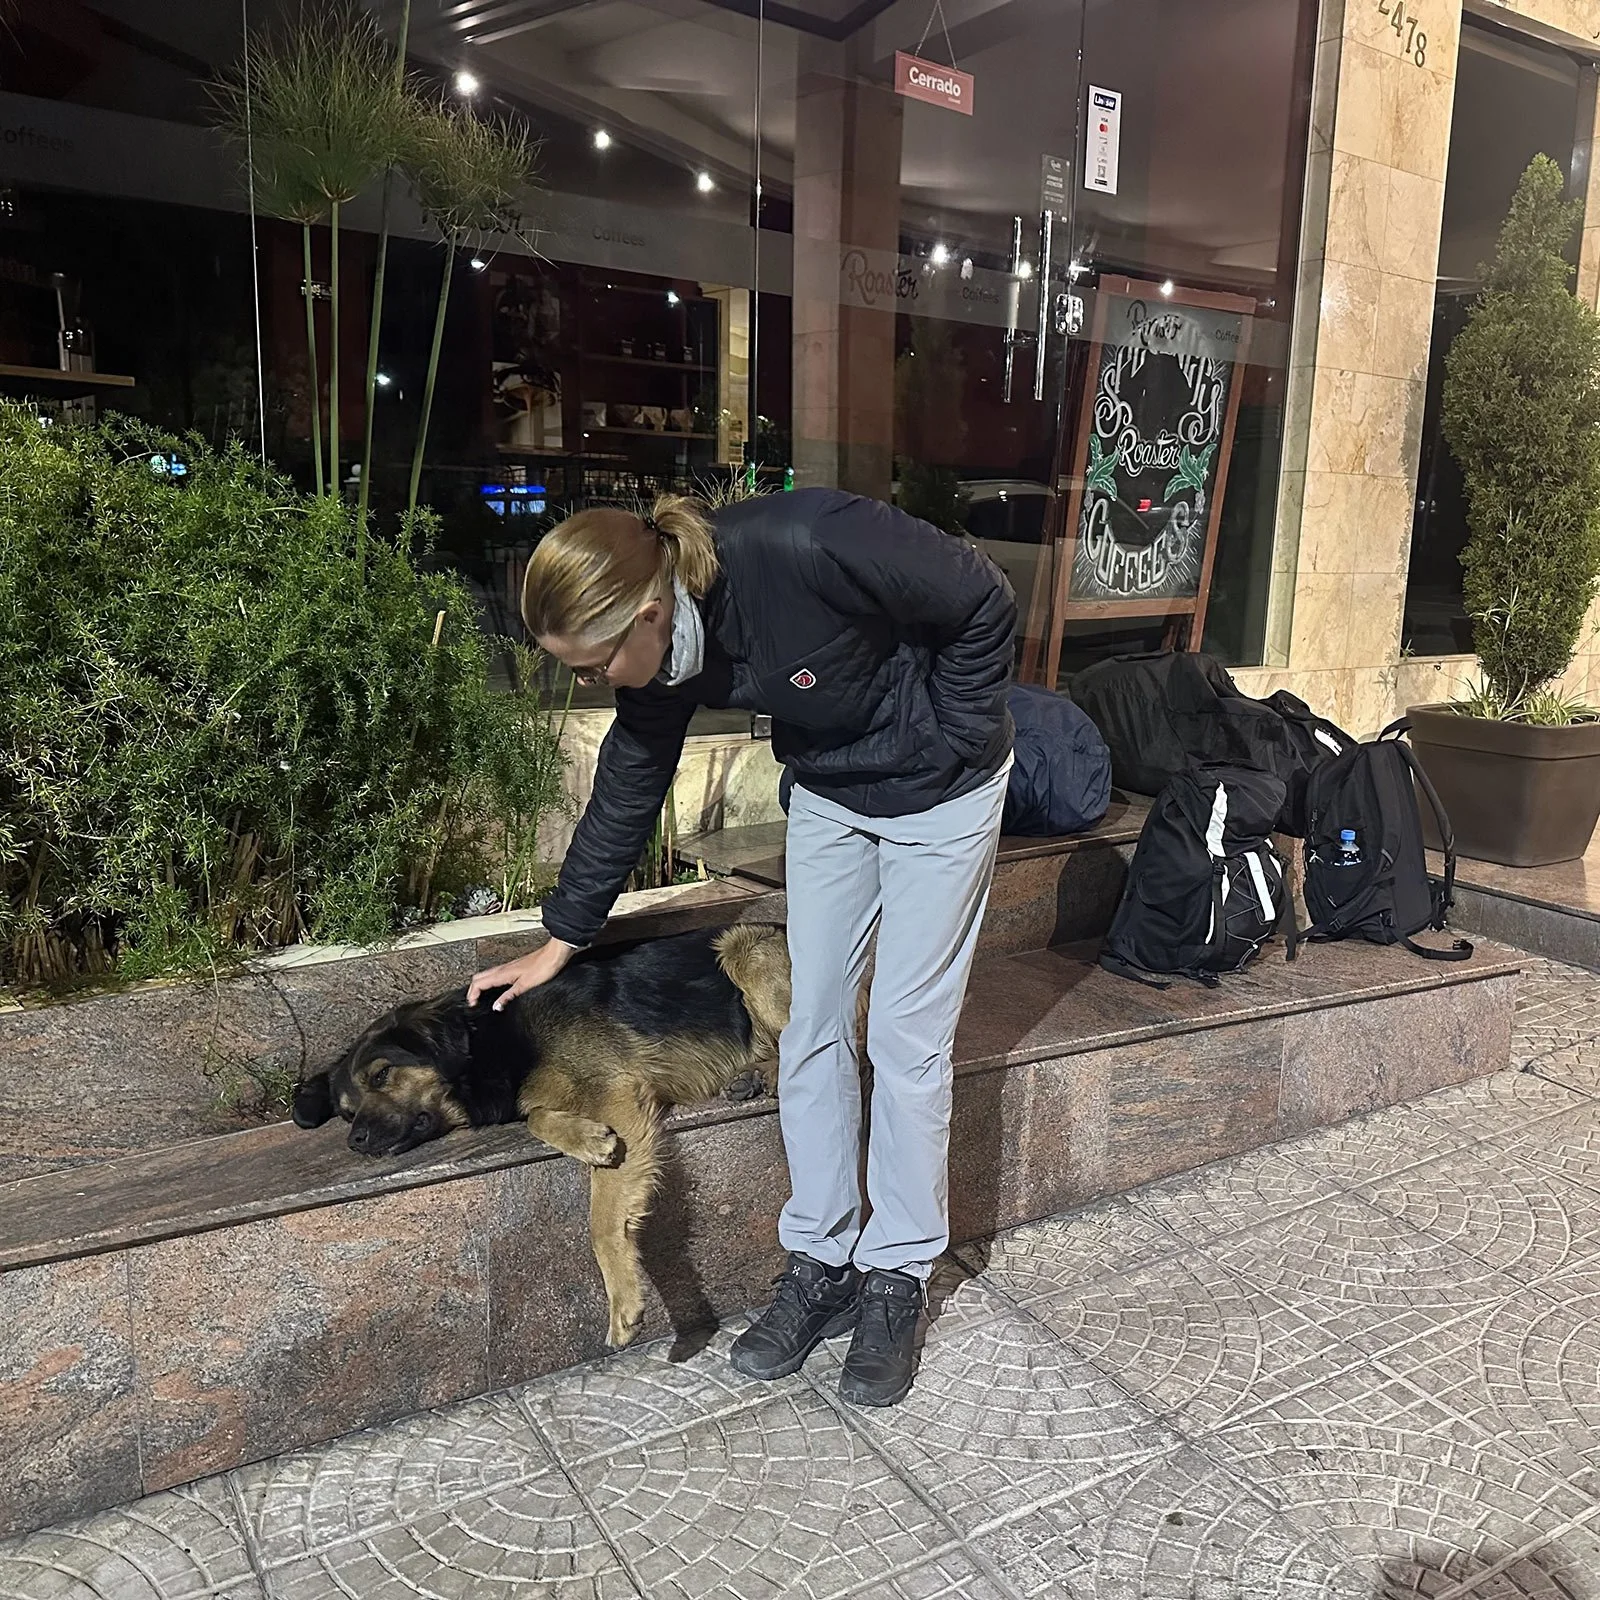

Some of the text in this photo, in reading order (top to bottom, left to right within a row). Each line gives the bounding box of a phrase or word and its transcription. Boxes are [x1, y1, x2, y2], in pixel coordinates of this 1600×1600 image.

[909, 66, 961, 97] Cerrado
[841, 250, 919, 305] Roaster
[1119, 428, 1179, 475] Roaster
[1088, 498, 1190, 592] COFFEES
